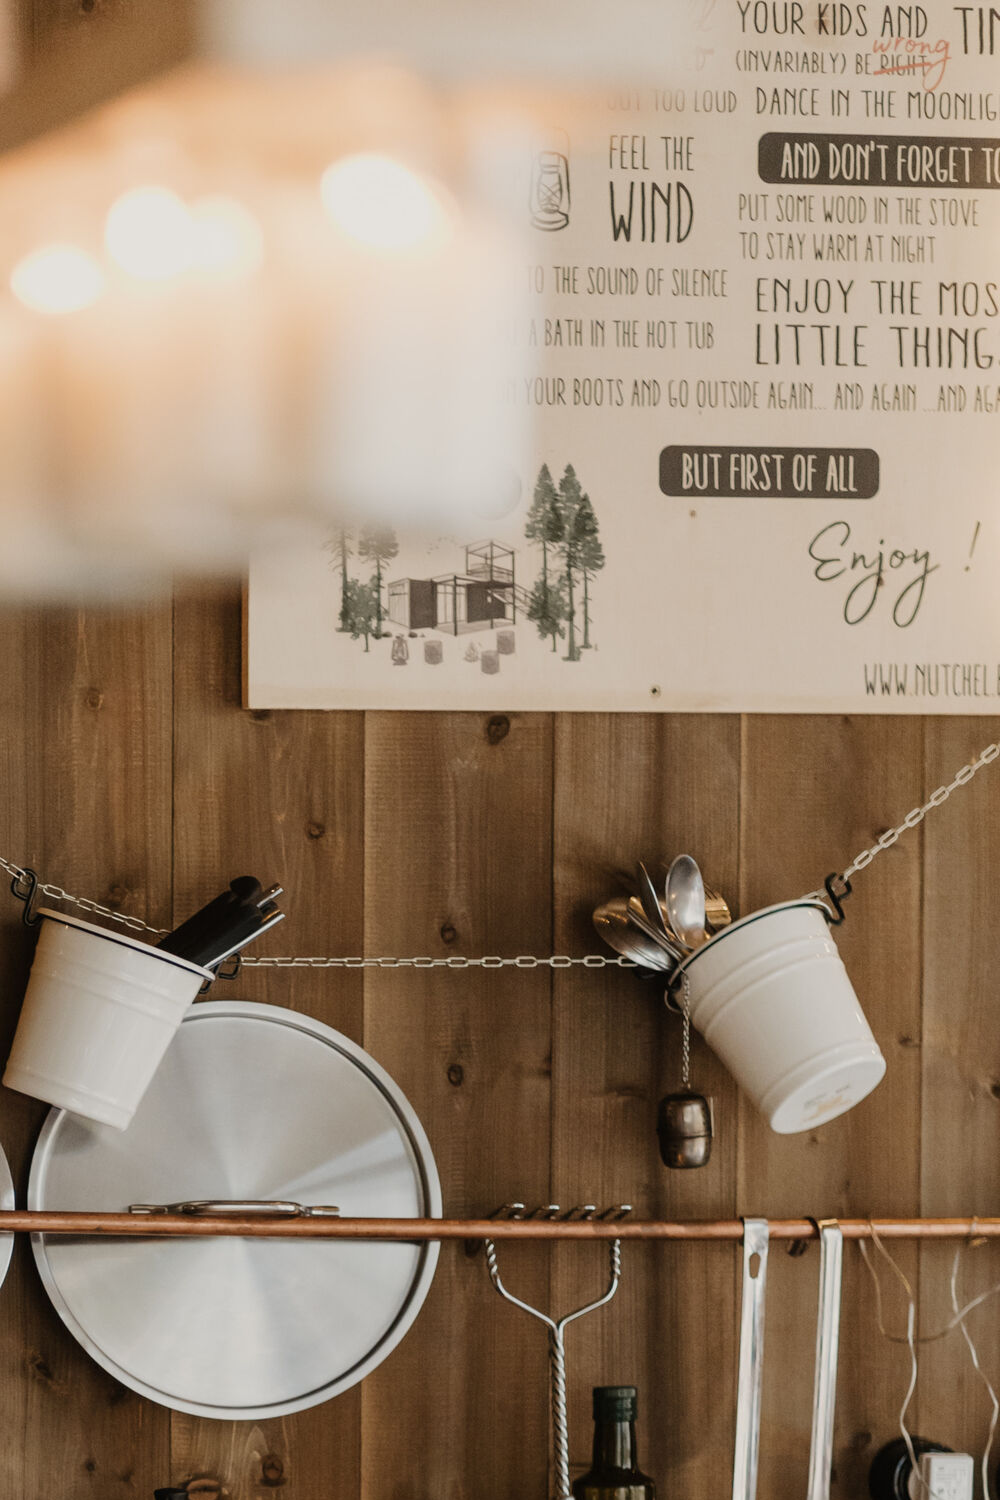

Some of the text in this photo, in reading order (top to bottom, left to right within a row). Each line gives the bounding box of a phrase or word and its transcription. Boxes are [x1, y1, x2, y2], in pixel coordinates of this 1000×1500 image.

[737, 0, 927, 38] YOUR KIDS AND
[736, 49, 927, 77] (INVARIABLY) BE RIGHT
[872, 37, 951, 92] wrong
[654, 88, 685, 113] TOO
[694, 89, 737, 114] LOUD
[755, 86, 819, 116] DANCE
[831, 88, 850, 117] IN
[861, 89, 897, 118] THE
[608, 134, 695, 171] FEEL THE
[780, 141, 820, 180] AND
[828, 140, 889, 182] DON'T
[896, 144, 973, 184] FORGET
[608, 180, 694, 244] WIND
[738, 193, 980, 228] PUT SOME WOOD IN THE STOVE
[738, 231, 937, 264] TO STAY WARM AT NIGHT
[552, 266, 580, 295] THE
[586, 266, 639, 296] SOUND
[645, 267, 665, 297] OF
[671, 268, 729, 298] SILENCE
[756, 277, 854, 314] ENJOY
[870, 280, 923, 316] THE
[545, 319, 583, 348] BATH
[590, 319, 606, 348] IN
[612, 320, 640, 348] THE
[646, 320, 677, 349] HOT
[685, 321, 715, 350] TUB
[756, 323, 1000, 370] LITTLE THING
[524, 377, 566, 407] YOUR
[573, 377, 625, 407] BOOTS
[631, 378, 662, 408] AND
[668, 379, 689, 409] GO
[696, 379, 760, 410] OUTSIDE
[834, 382, 864, 411] AND
[871, 382, 917, 412] AGAIN
[681, 452, 858, 492] BUT FIRST OF ALL
[808, 520, 941, 628] Enjoy
